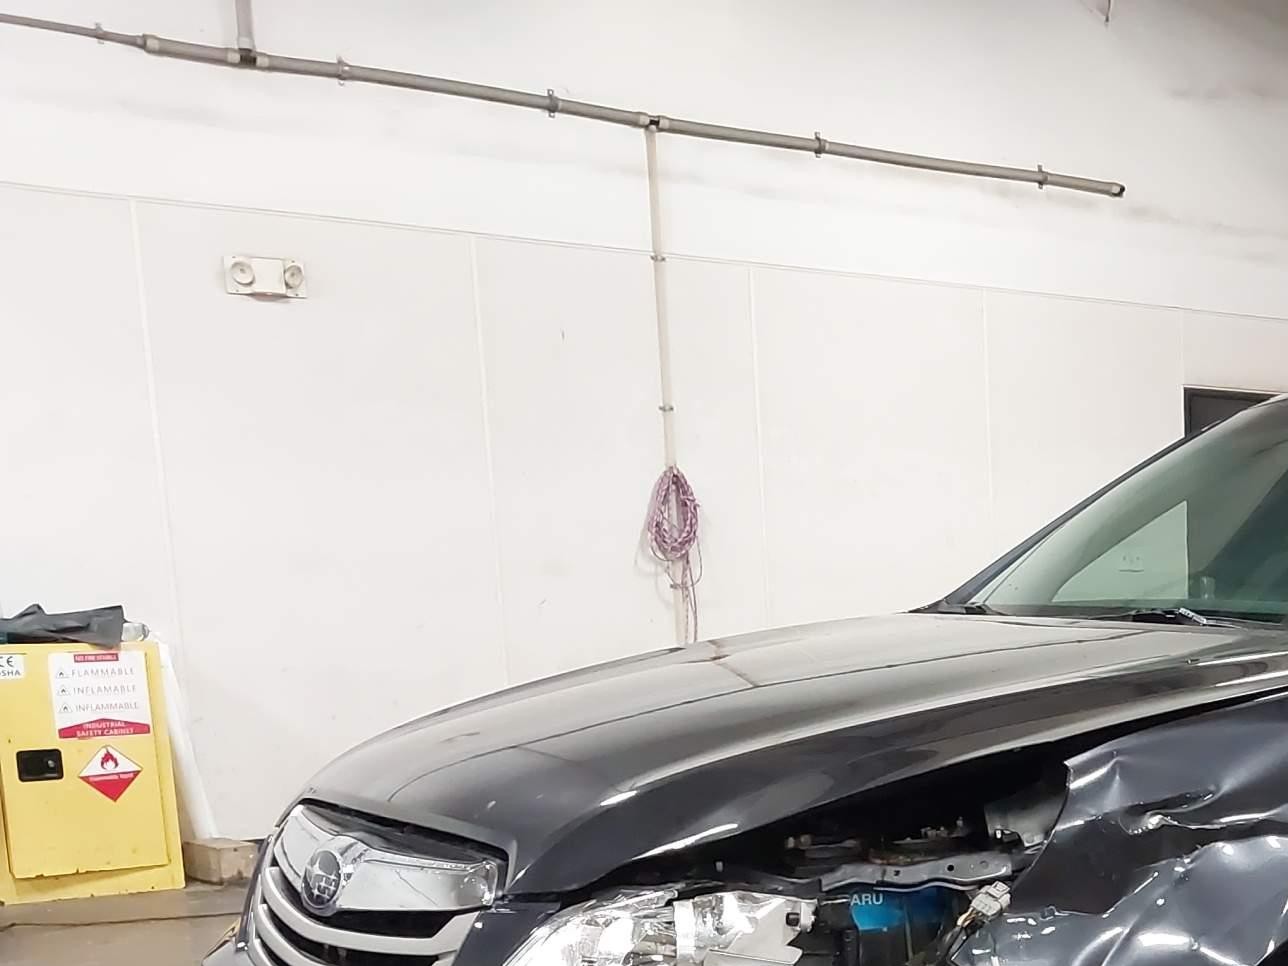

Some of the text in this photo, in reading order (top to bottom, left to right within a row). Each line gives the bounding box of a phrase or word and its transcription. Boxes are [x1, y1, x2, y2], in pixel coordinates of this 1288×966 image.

[0, 669, 21, 677] SHA
[72, 667, 134, 677] FLAMMABLE
[73, 685, 136, 695] INFLAMABLE
[75, 702, 139, 712] INFLAMMABLE
[83, 720, 126, 729] INDUSTRIAL
[76, 729, 102, 737] SAFETY
